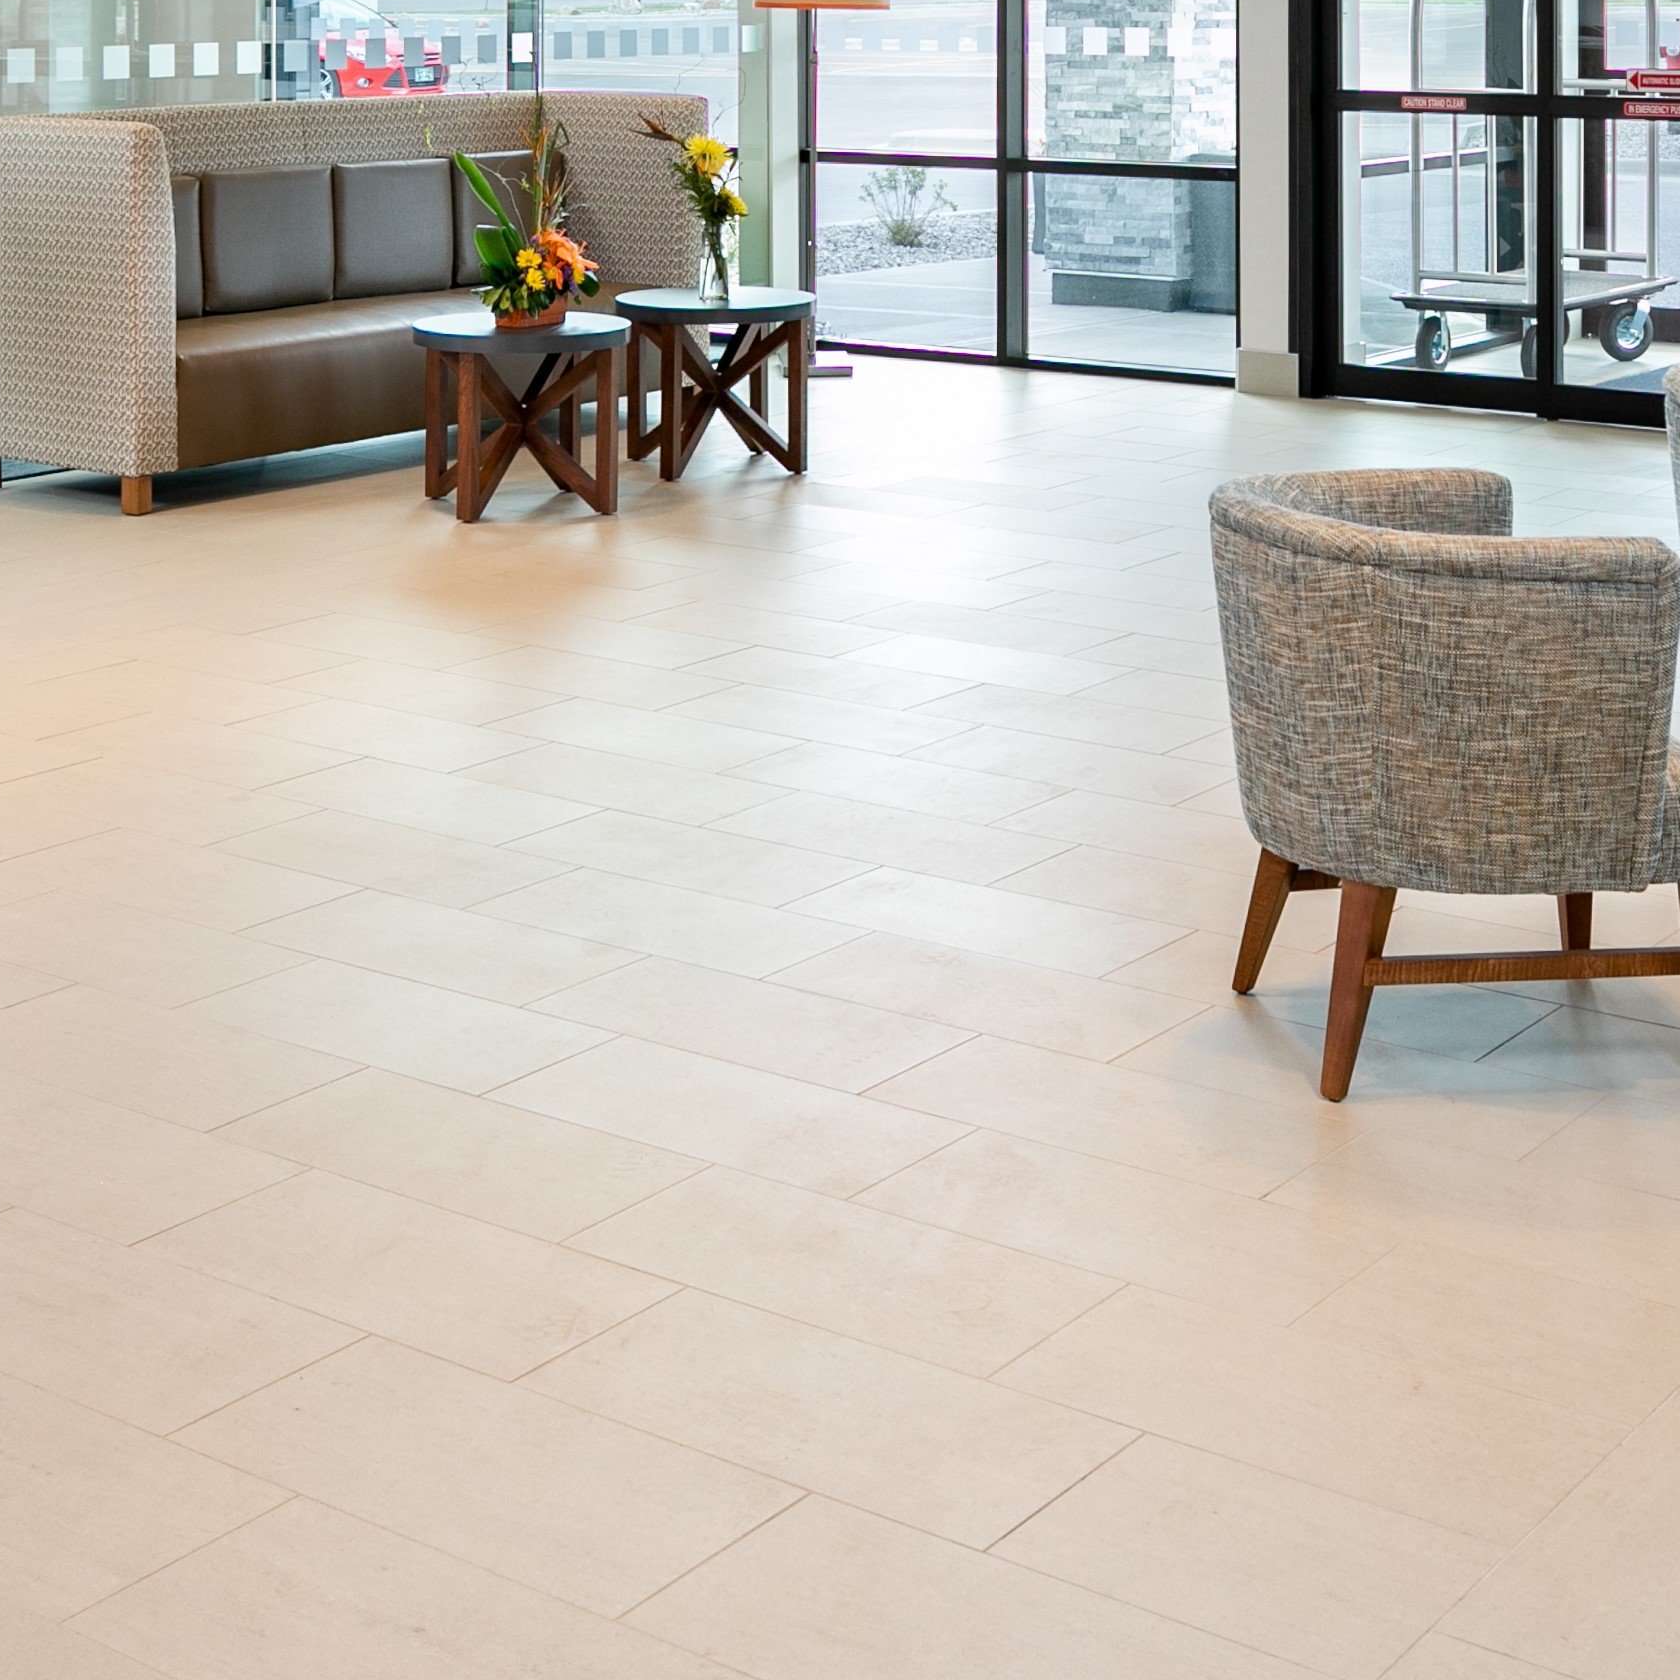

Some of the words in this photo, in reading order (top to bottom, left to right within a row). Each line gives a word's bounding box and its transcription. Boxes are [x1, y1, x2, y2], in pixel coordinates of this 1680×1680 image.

[1642, 77, 1669, 85] AUTOMATIC
[1404, 98, 1427, 107] CAUTION
[1428, 98, 1445, 107] STAND
[1446, 99, 1464, 109] CLEAR
[1628, 105, 1635, 113] IN
[1636, 104, 1670, 114] EMERGENCY
